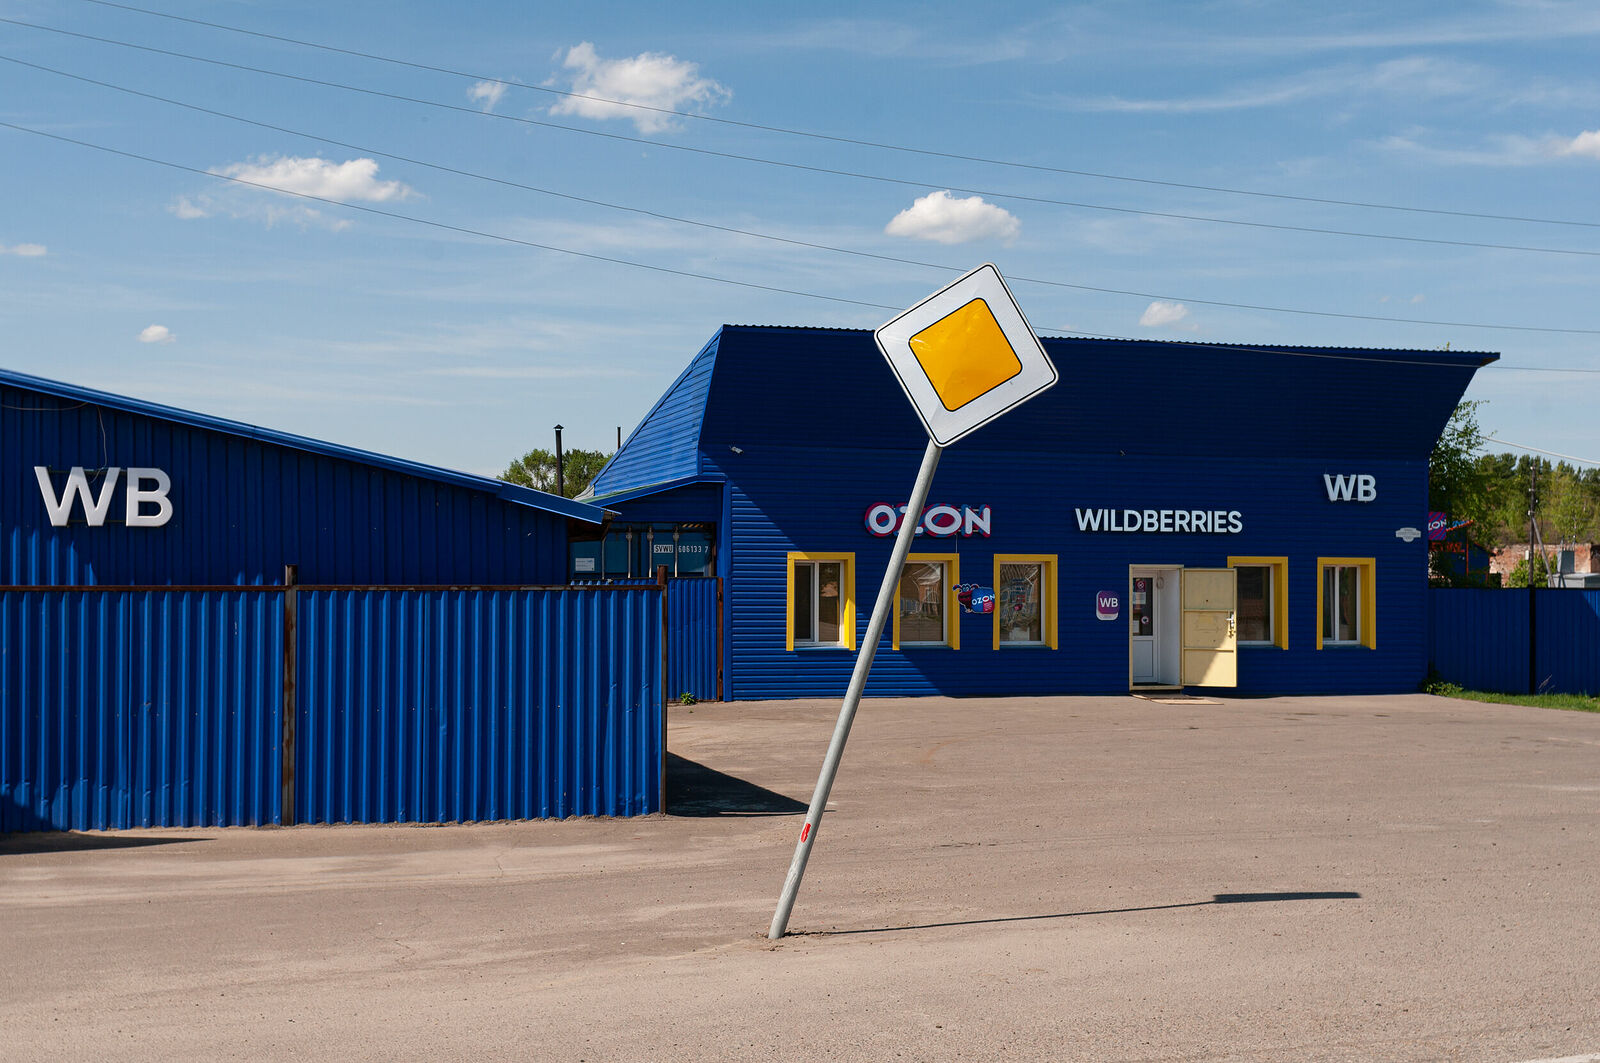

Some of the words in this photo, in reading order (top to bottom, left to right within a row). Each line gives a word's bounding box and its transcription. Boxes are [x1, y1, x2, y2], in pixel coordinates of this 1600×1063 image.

[33, 465, 174, 528] WB
[1323, 474, 1377, 502] WB
[1075, 508, 1244, 533] WILDBERRIES
[654, 544, 674, 554] SVWU
[971, 594, 995, 605] OZON
[1099, 597, 1119, 608] WB
